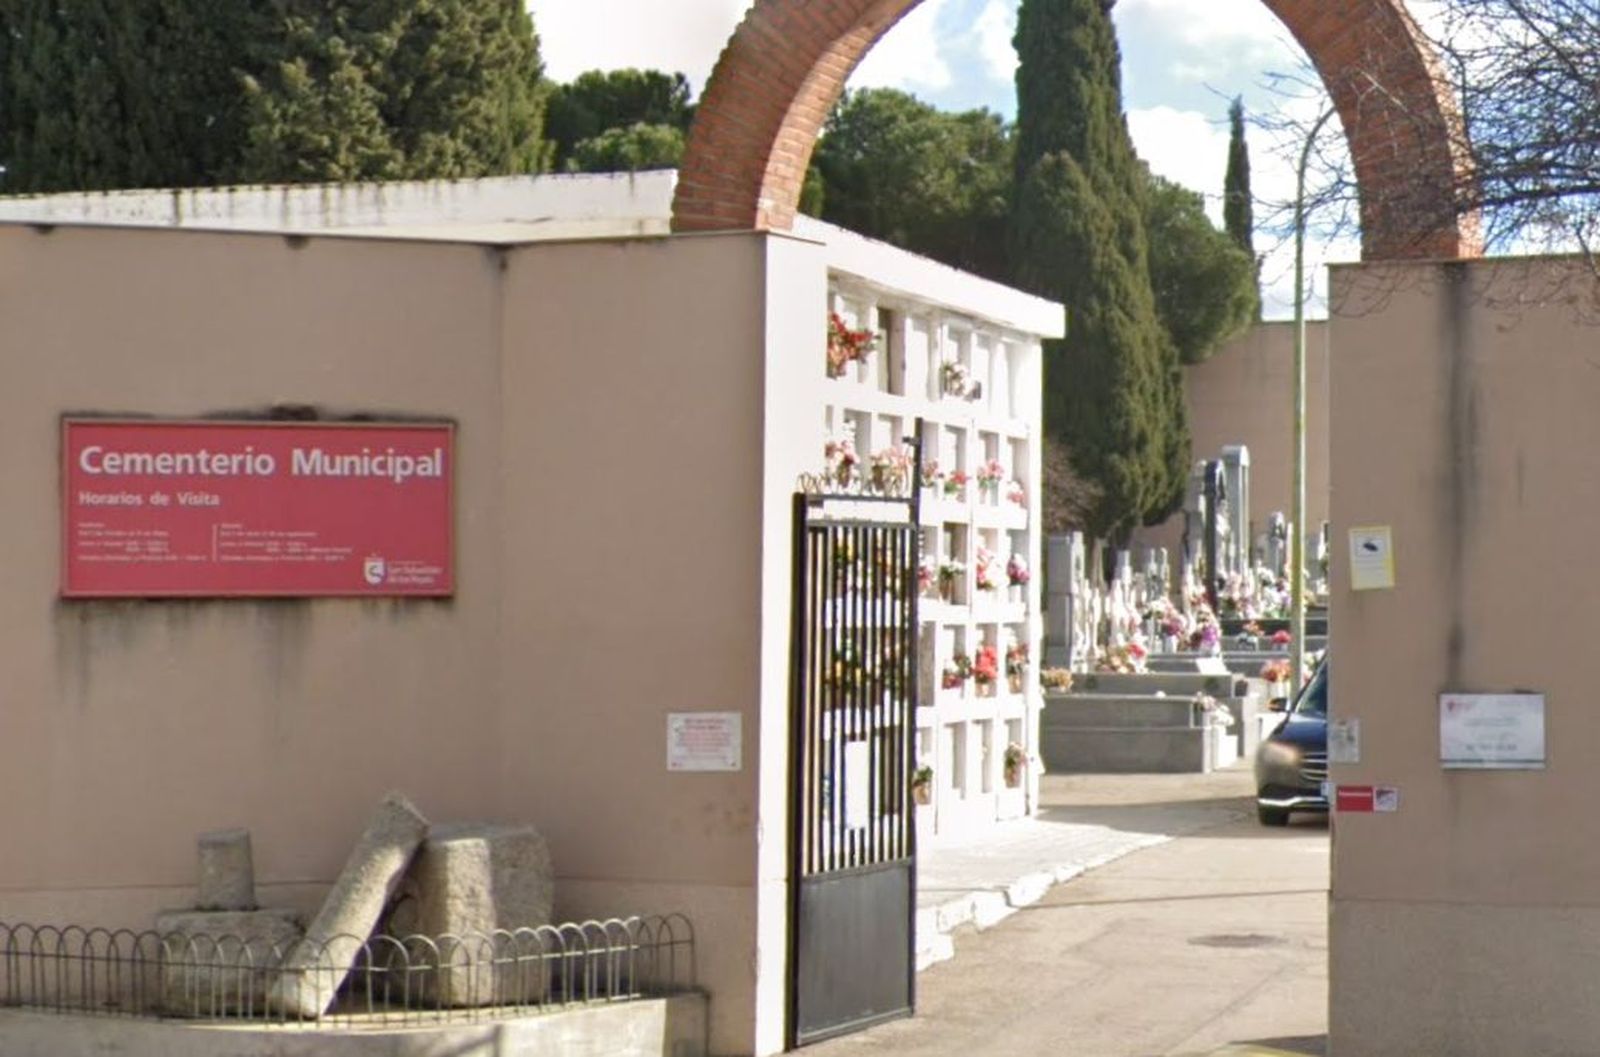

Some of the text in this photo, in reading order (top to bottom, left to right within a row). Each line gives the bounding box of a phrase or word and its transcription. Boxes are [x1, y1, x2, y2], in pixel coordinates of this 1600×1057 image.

[79, 446, 443, 483] Cementerio Municipal
[79, 491, 221, 506] Horarios de Visita
